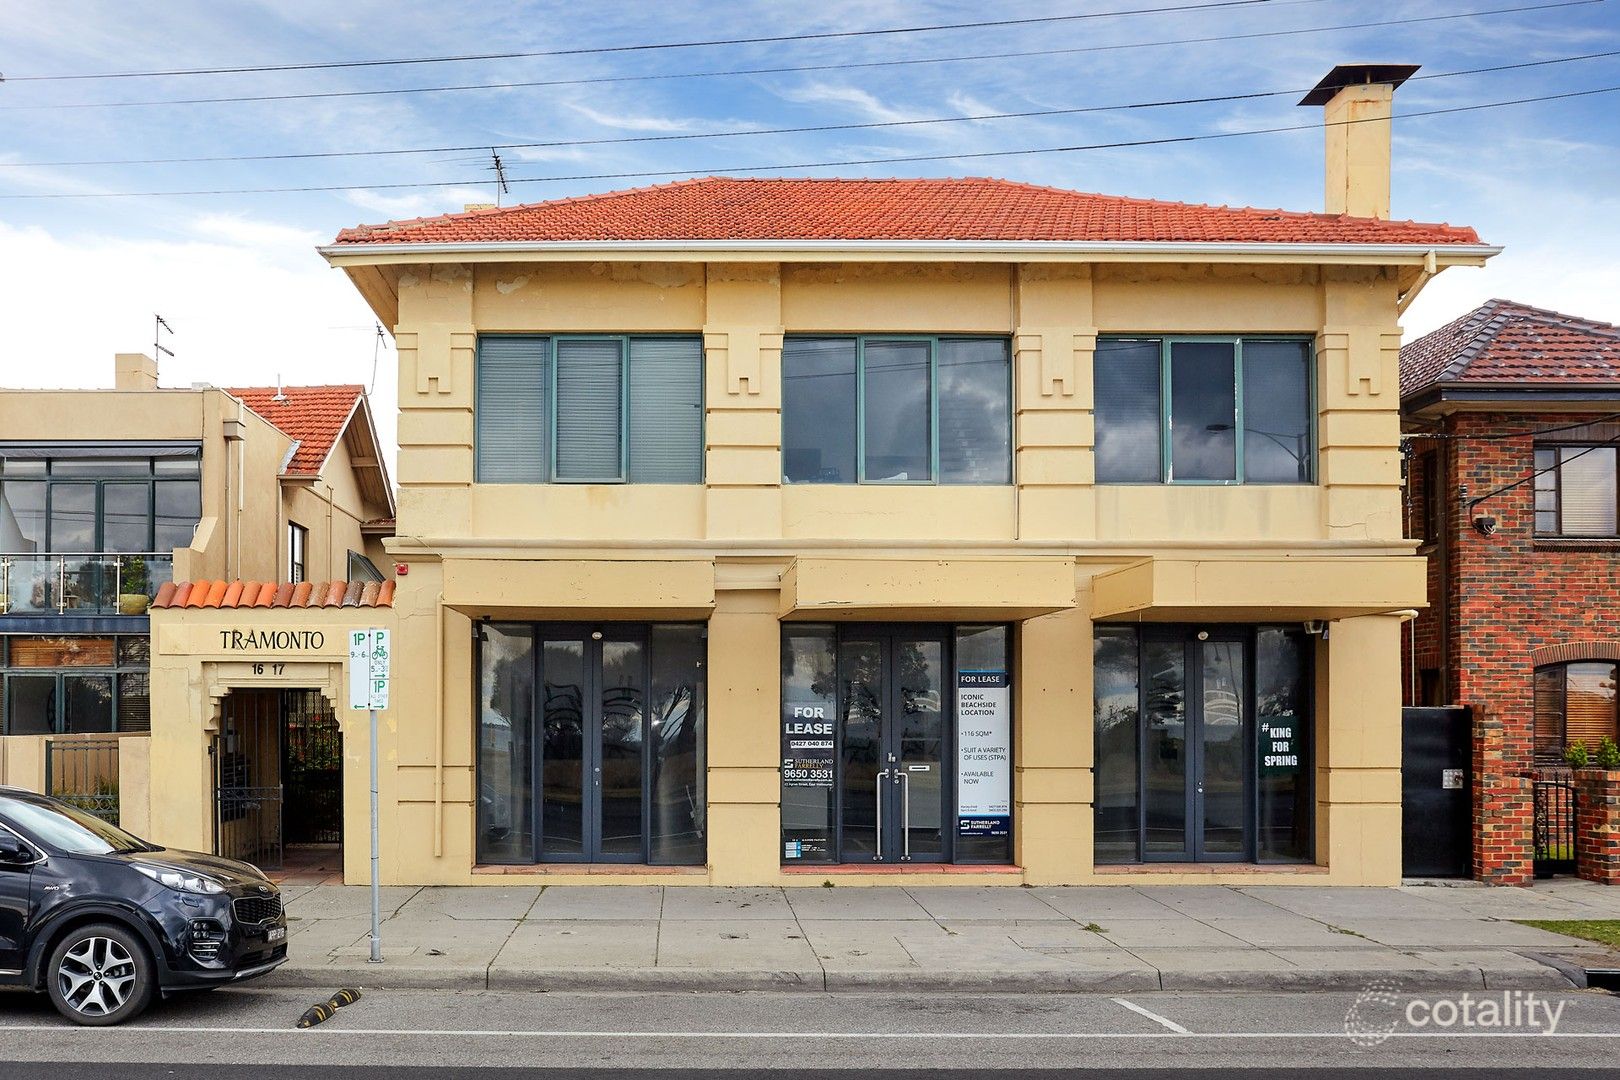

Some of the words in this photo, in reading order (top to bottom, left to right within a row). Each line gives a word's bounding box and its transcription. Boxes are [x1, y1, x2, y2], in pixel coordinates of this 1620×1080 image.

[219, 630, 324, 650] TRAMONTO
[353, 633, 365, 646] 1P
[376, 632, 384, 644] P
[251, 663, 265, 675] 16
[271, 663, 286, 676] 17
[374, 680, 386, 693] 1P
[794, 706, 824, 718] FOR
[786, 723, 832, 734] LEASE
[1272, 741, 1290, 752] FOR
[1264, 755, 1298, 767] SPRING
[784, 770, 808, 778] 9650
[810, 770, 833, 778] 3531
